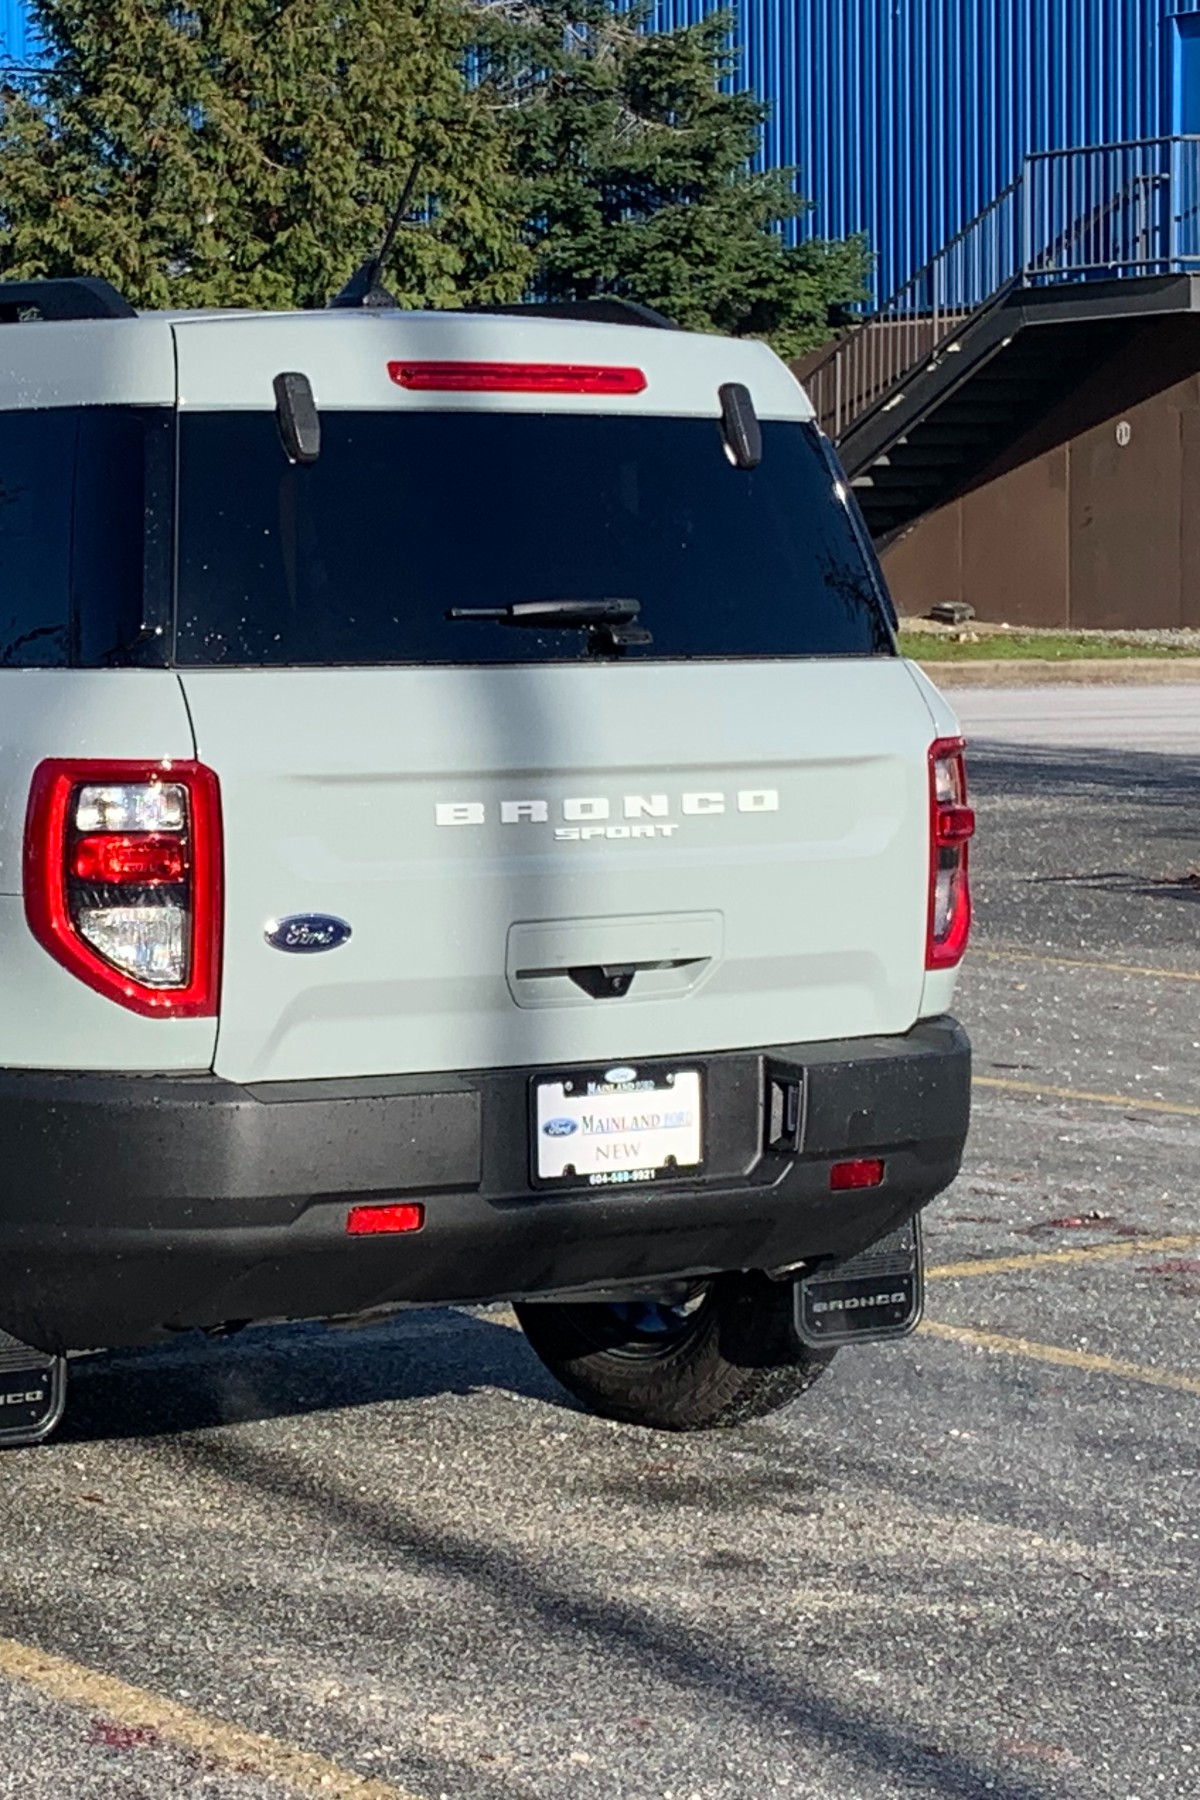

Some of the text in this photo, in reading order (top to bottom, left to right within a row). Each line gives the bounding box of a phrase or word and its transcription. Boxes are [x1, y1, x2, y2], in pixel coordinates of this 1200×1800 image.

[435, 790, 780, 826] BRONCO
[553, 823, 679, 841] SPORT
[595, 1142, 642, 1161] NEW
[812, 1291, 907, 1313] BRONCO
